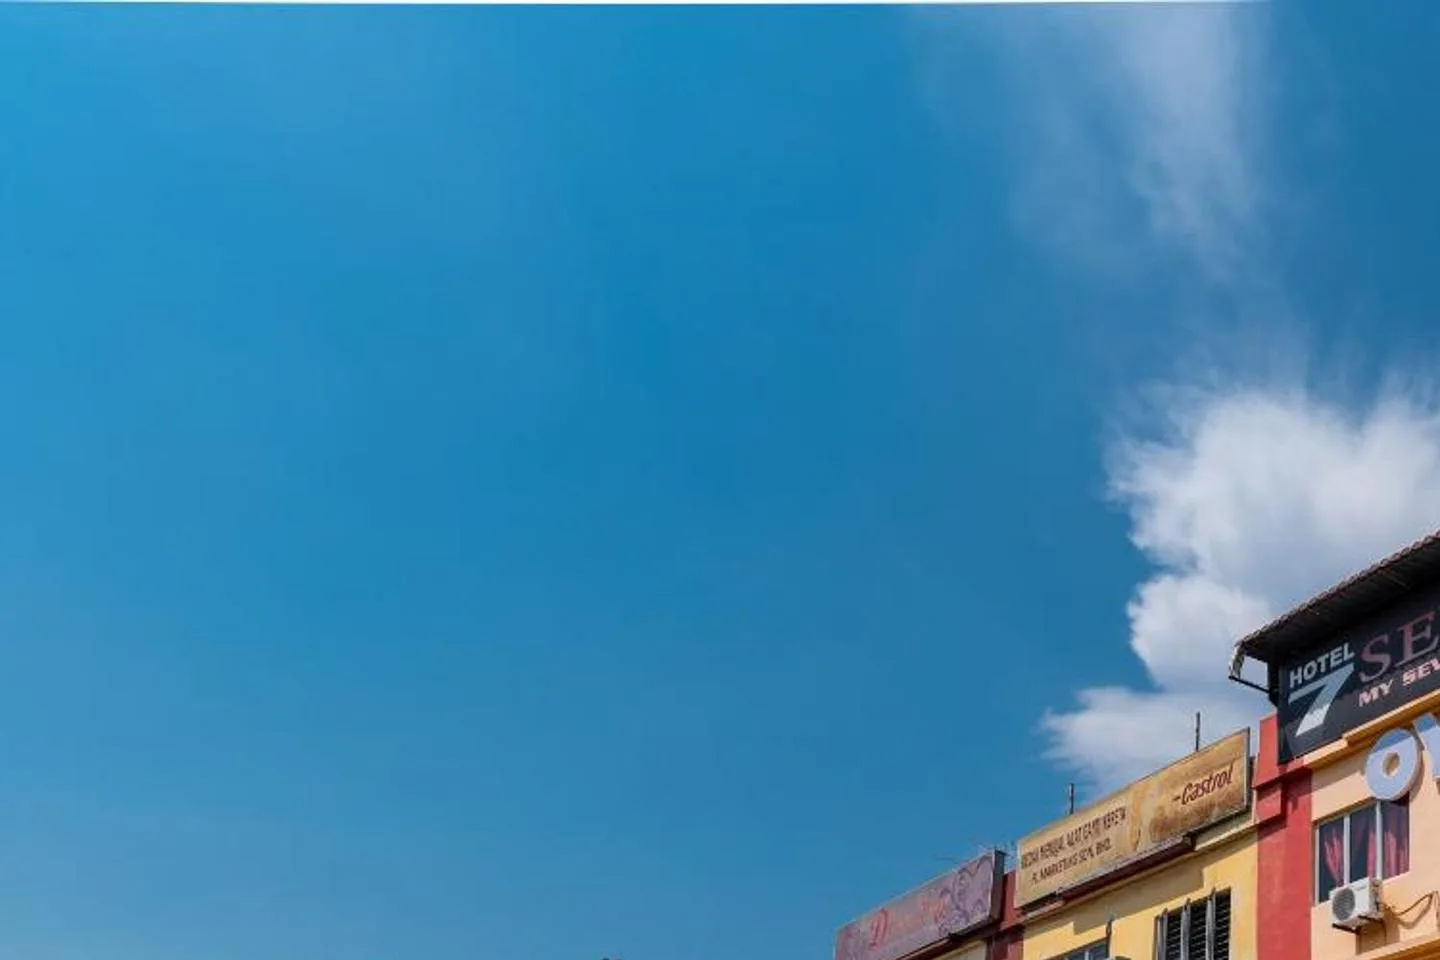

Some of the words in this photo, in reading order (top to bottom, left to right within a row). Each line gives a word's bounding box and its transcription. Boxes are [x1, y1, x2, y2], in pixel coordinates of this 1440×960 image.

[1288, 643, 1355, 688] HOTEL
[1288, 663, 1355, 737] 7
[1358, 679, 1393, 708] MY
[1181, 761, 1234, 806] Castrol
